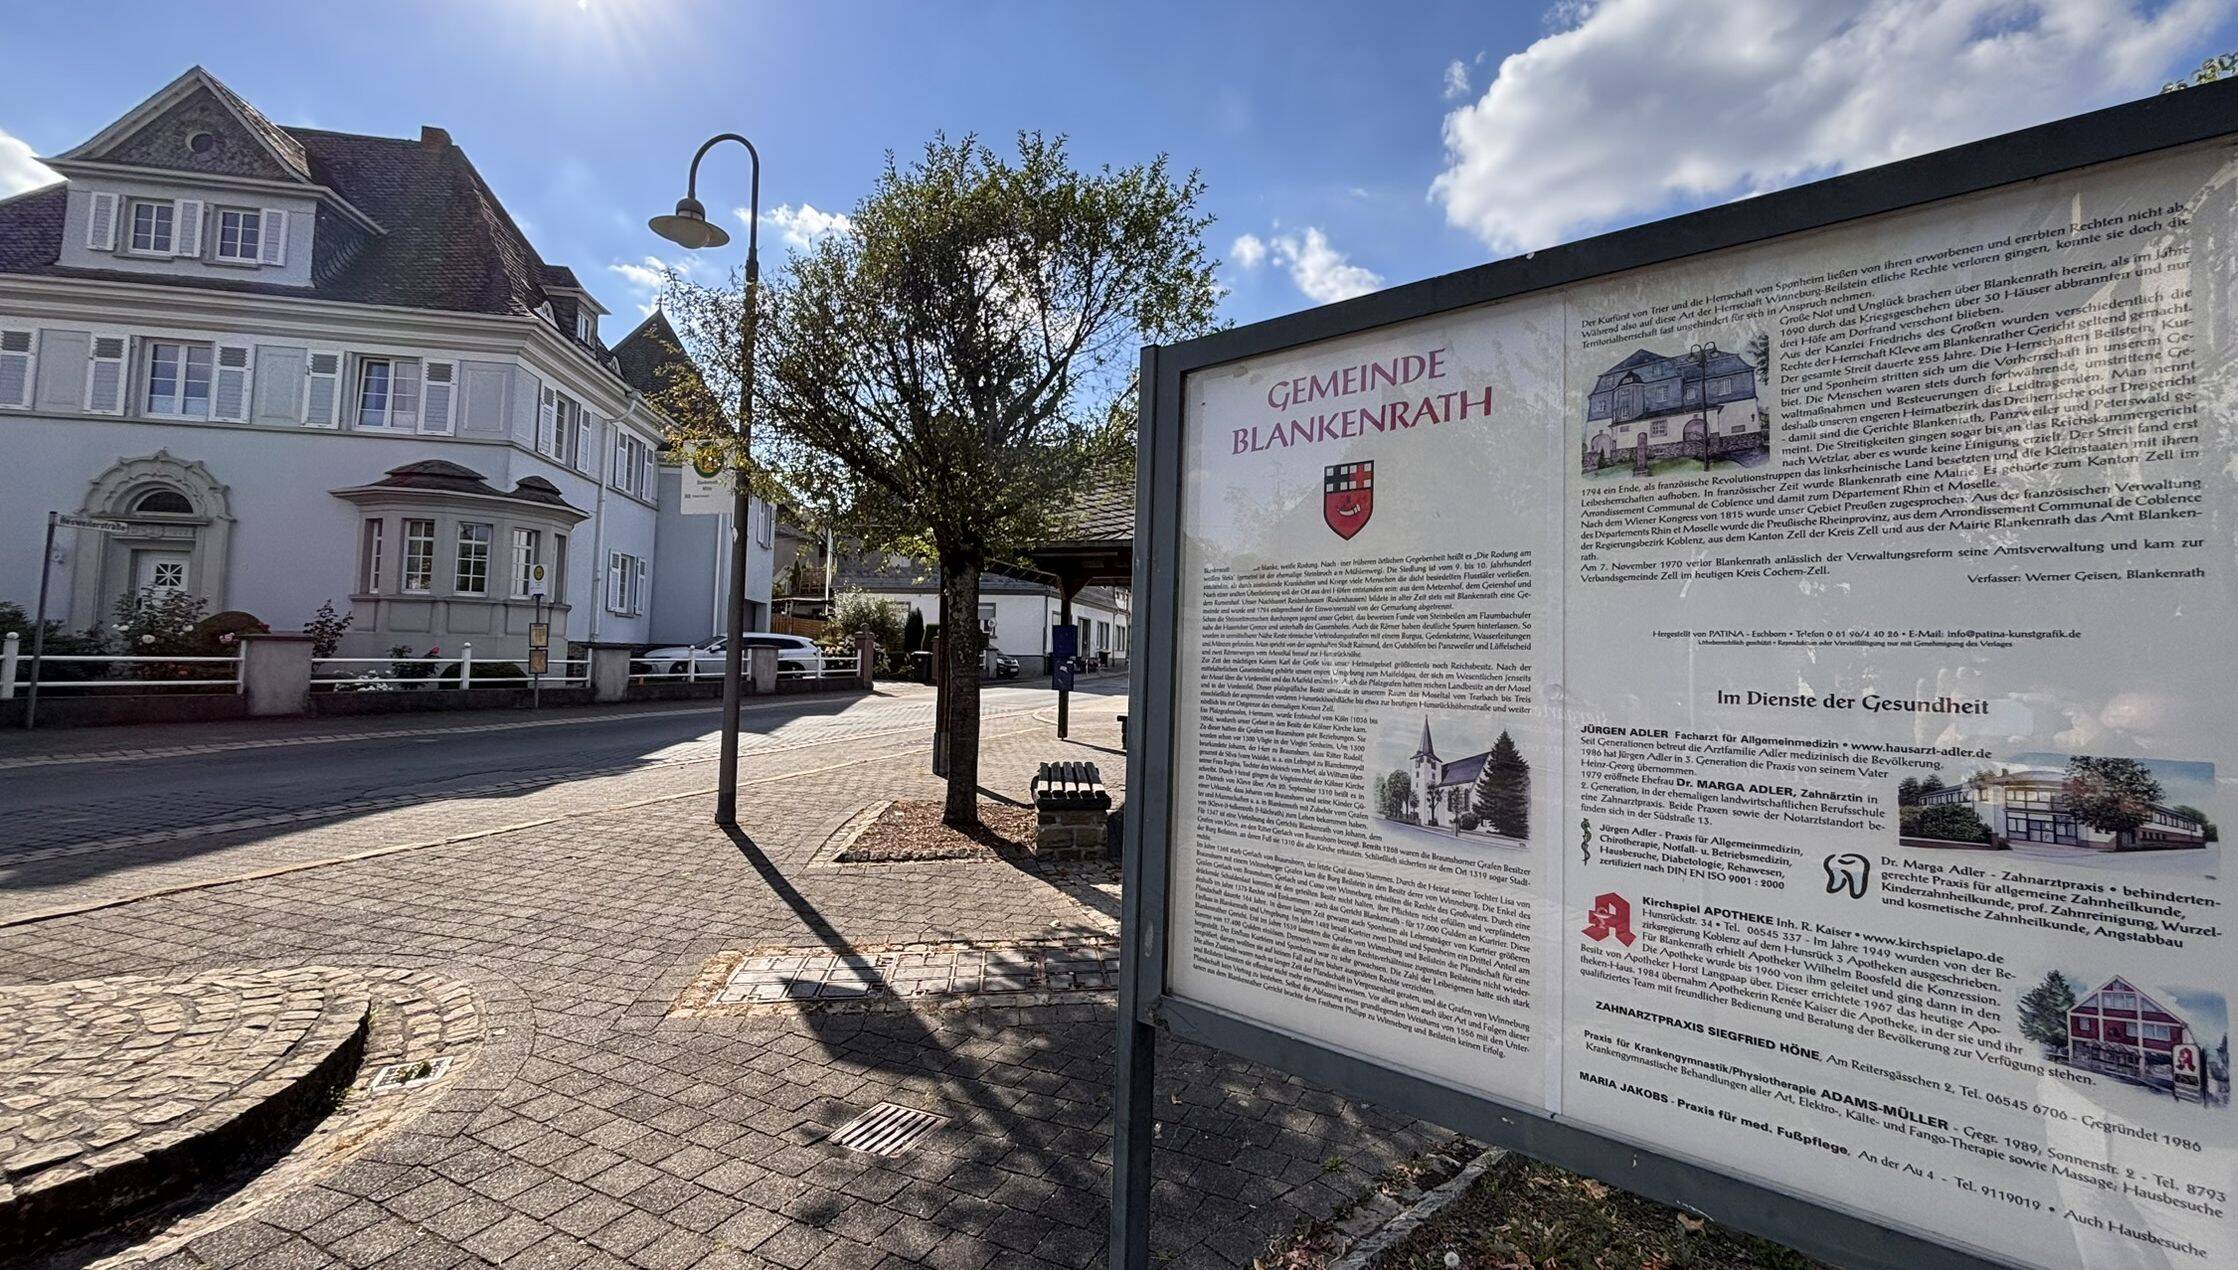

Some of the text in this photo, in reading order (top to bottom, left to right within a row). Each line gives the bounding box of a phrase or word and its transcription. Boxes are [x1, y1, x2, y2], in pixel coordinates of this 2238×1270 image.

[1778, 312, 1811, 326] Große
[1812, 308, 1833, 320] Not
[1835, 303, 1856, 316] und
[1857, 295, 1905, 312] Unglück
[1906, 289, 1952, 303] brachen
[1954, 283, 1981, 295] über
[1983, 268, 2058, 289] Blankenrath
[2061, 261, 2107, 276] herein,
[2110, 255, 2130, 267] als
[2132, 253, 2151, 263] im
[1267, 348, 1446, 412] GEMEINDE
[1231, 386, 1493, 455] BLANKENRATH
[1490, 549, 1518, 558] Rodung
[1580, 563, 1597, 572] Am
[1611, 560, 1657, 571] November
[1660, 560, 1683, 569] 1970
[1685, 558, 1712, 568] verlor
[1715, 555, 1771, 566] Blankenrath
[1774, 553, 1822, 564] anlässlich
[1826, 552, 1843, 562] der
[1846, 548, 1953, 561] Verwaltungsreform
[1957, 547, 1988, 557] seine
[1993, 541, 2104, 556] Amtsverwaltung
[2110, 539, 2137, 551] und
[2144, 538, 2175, 549] kam
[2181, 539, 2204, 548] zur
[1580, 565, 1830, 583] Verbandsgemeinde Zell im heutigen Kreis Cochem-Zell.
[1967, 567, 2205, 583] Verfasser: Werner Geisen, Blankenrath
[1708, 630, 1745, 638] PATINA
[1751, 629, 1787, 638] Eschborn
[1826, 630, 1834, 638] 0
[1835, 630, 1845, 638] 61
[1873, 630, 1885, 638] 40
[1908, 629, 1944, 638] E-Mail:
[1947, 629, 2081, 640] info@patina-kunstgrafik.de
[1432, 661, 1448, 669] noch
[1496, 662, 1517, 670] Nach
[1519, 663, 1532, 671] der
[1718, 689, 1989, 714] Im Dienste der Gesundheit
[1580, 723, 1992, 759] JÜRGEN ADLER Facharzt für Allgemeinmedizin www.hausarzt-adler.de
[1581, 770, 1878, 804] 1979 eröffnete Ehefrau Dr. MARGA ADLER, Zahnärztin in
[1599, 857, 1785, 890] zertifiziert nach DIN EN ISO 9001 2000
[1881, 856, 2221, 907] Dr. Marga Adler Zahnarztpraxis behinderten-
[1642, 896, 2004, 964] Kirchspiel APOTHEKE Inh. R. Kaiser www.kirchspielapo.de
[1881, 897, 2183, 948] und kosmetische Zahnheilkunde, Angstabbau
[1642, 907, 2016, 980] Hunsrückstr. 34 Tel. 06545 337 Im Jahre 1949 wurden von der Be-
[1367, 1013, 1375, 1021] zu
[1376, 1013, 1413, 1033] Winneburg
[1413, 1026, 1427, 1036] und
[1427, 1028, 1456, 1044] Beilstein
[1457, 1036, 1481, 1051] keinen
[1595, 1000, 1704, 1033] ZAHNARZTPRAXIS
[1707, 1026, 1776, 1050] SIEGFRIED
[1825, 1054, 1848, 1067] Am
[1851, 1059, 1940, 1090] Reitersgässchen
[1961, 1085, 1982, 1100] Tel.
[1985, 1092, 2028, 1111] 06545
[2032, 1103, 2068, 1120] 6706
[2081, 1115, 2158, 1142] Gegründet
[2162, 1134, 2202, 1152] 1986
[1584, 1029, 1612, 1044] Praxis
[1616, 1037, 1630, 1048] für
[1634, 1042, 1816, 1096] Krankengymnastik/Physiotherapie
[1820, 1089, 1948, 1131] ADAMS-MÜLLER
[1963, 1126, 1998, 1144] Gegr.
[2047, 1147, 2119, 1175] Sonnenstr.
[2125, 1168, 2135, 1180] 2
[2153, 1173, 2179, 1191] Tel.
[2186, 1183, 2226, 1203] 8793
[1579, 1071, 1617, 1089] MARIA
[1619, 1083, 1668, 1103] JAKOBS
[1677, 1098, 1715, 1116] Praxis
[1718, 1109, 1737, 1122] für
[1740, 1118, 1773, 1133] med.
[1857, 1150, 1877, 1163] An
[1880, 1156, 1900, 1169] der
[1902, 1163, 1923, 1177] Au
[1926, 1170, 1934, 1180] 4
[1954, 1176, 1977, 1192] Tel.
[1981, 1185, 2041, 1210] 9119019
[2063, 1209, 2104, 1229] Auch
[2108, 1220, 2207, 1258] Hausbesuche
